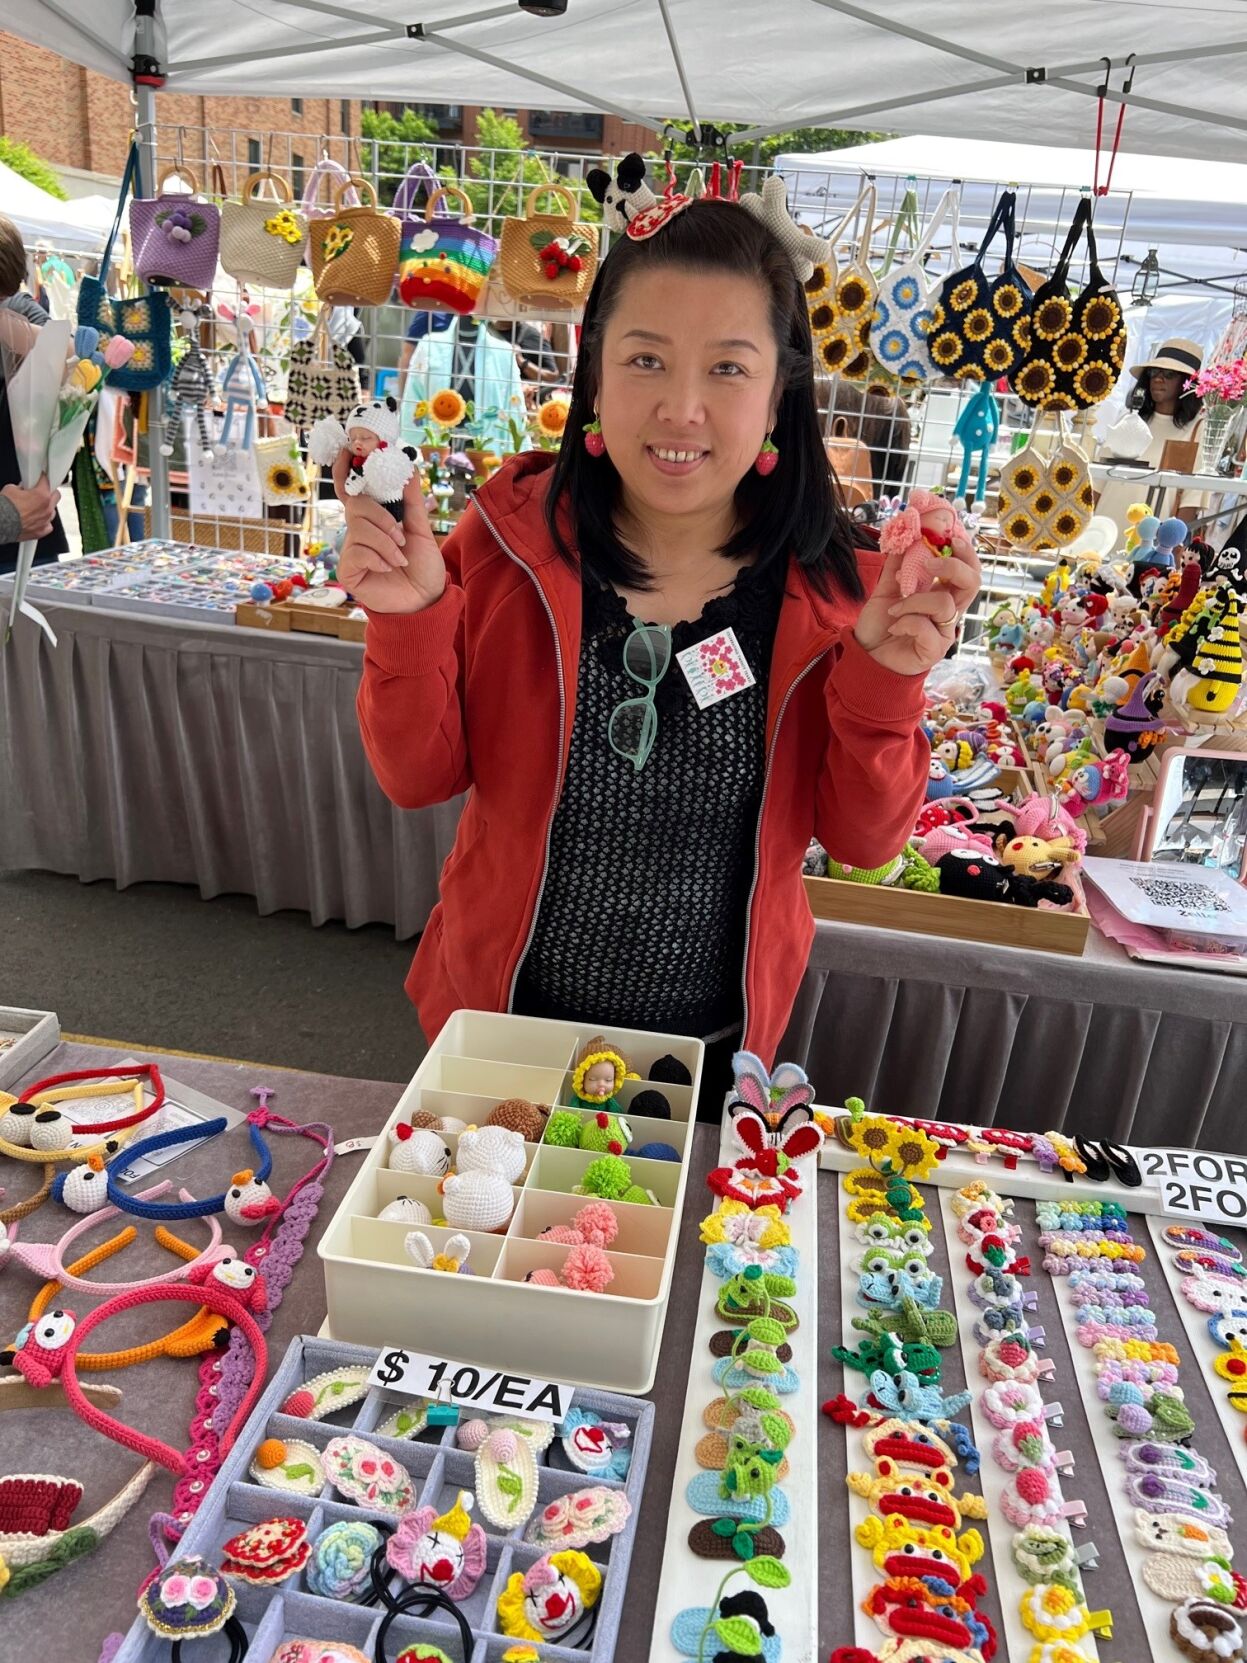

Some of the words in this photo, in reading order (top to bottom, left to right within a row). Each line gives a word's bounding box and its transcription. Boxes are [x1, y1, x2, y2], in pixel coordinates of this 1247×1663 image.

[1143, 1153, 1247, 1185] 2FOR
[377, 1350, 410, 1386] $
[428, 1361, 562, 1417] 10/EA
